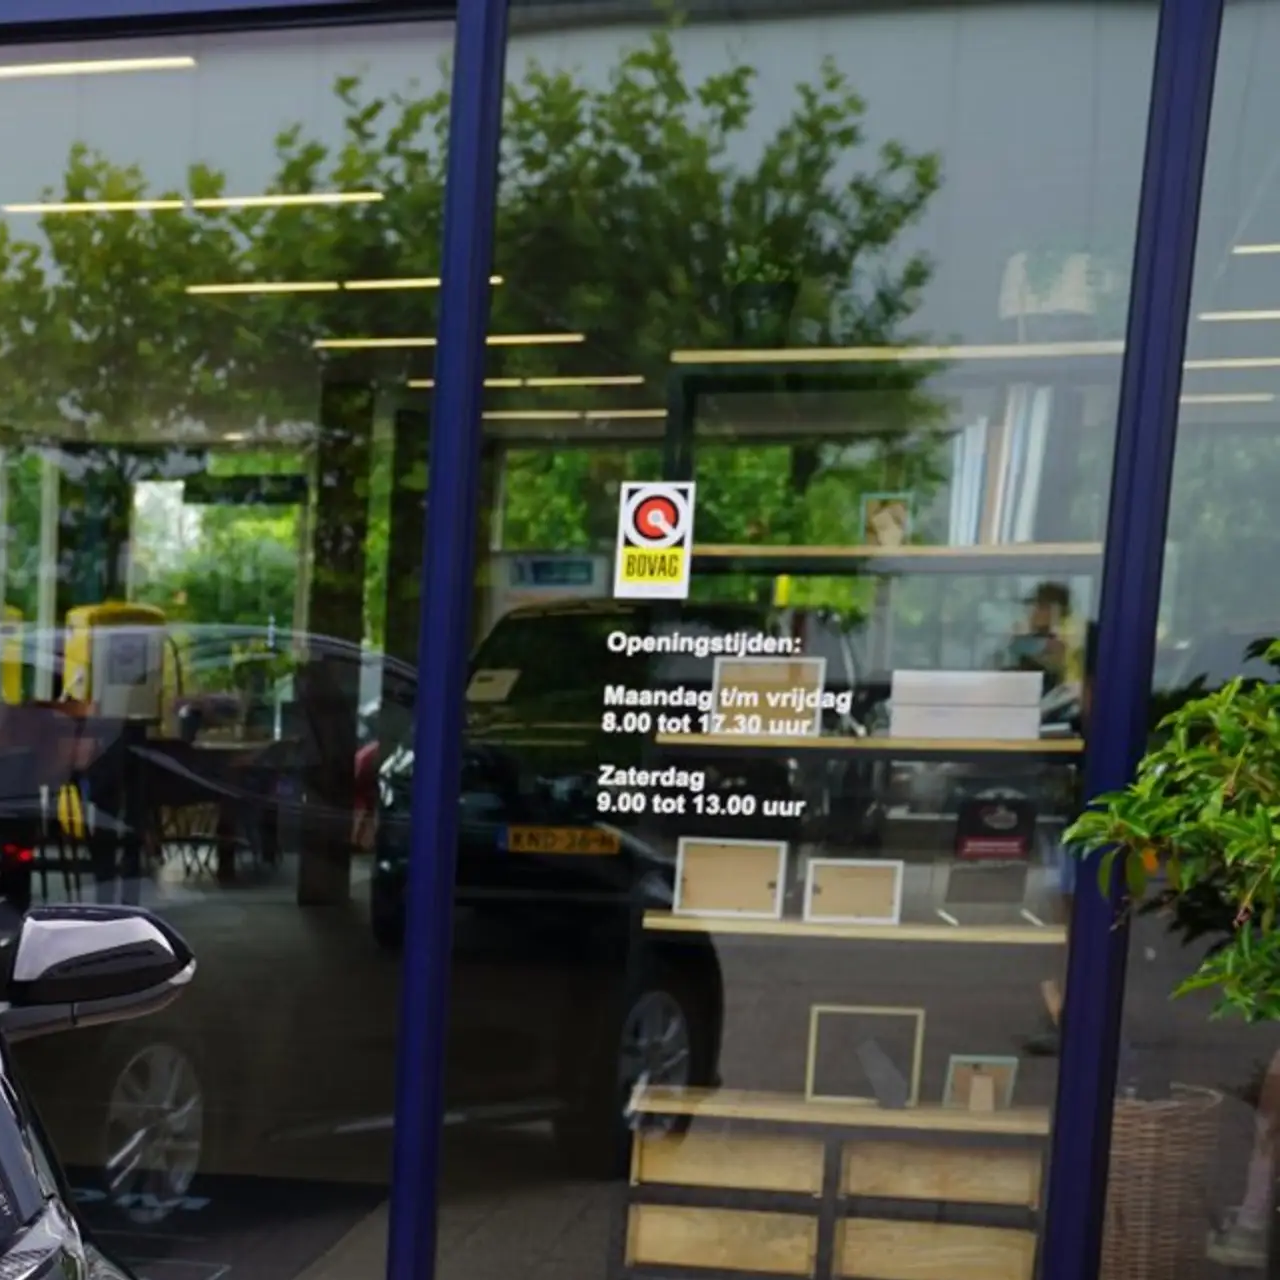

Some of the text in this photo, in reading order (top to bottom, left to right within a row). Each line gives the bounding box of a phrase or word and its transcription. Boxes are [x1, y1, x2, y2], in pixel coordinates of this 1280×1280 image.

[625, 554, 679, 578] BOVAG
[607, 631, 802, 657] Openingstijden:
[603, 685, 853, 713] Maandag t/m vrijdag
[601, 712, 813, 736] 8.00 tot 17.30 uur
[597, 765, 705, 792] Zaterdag
[596, 792, 807, 816] 9.00 tot 13.00 uur
